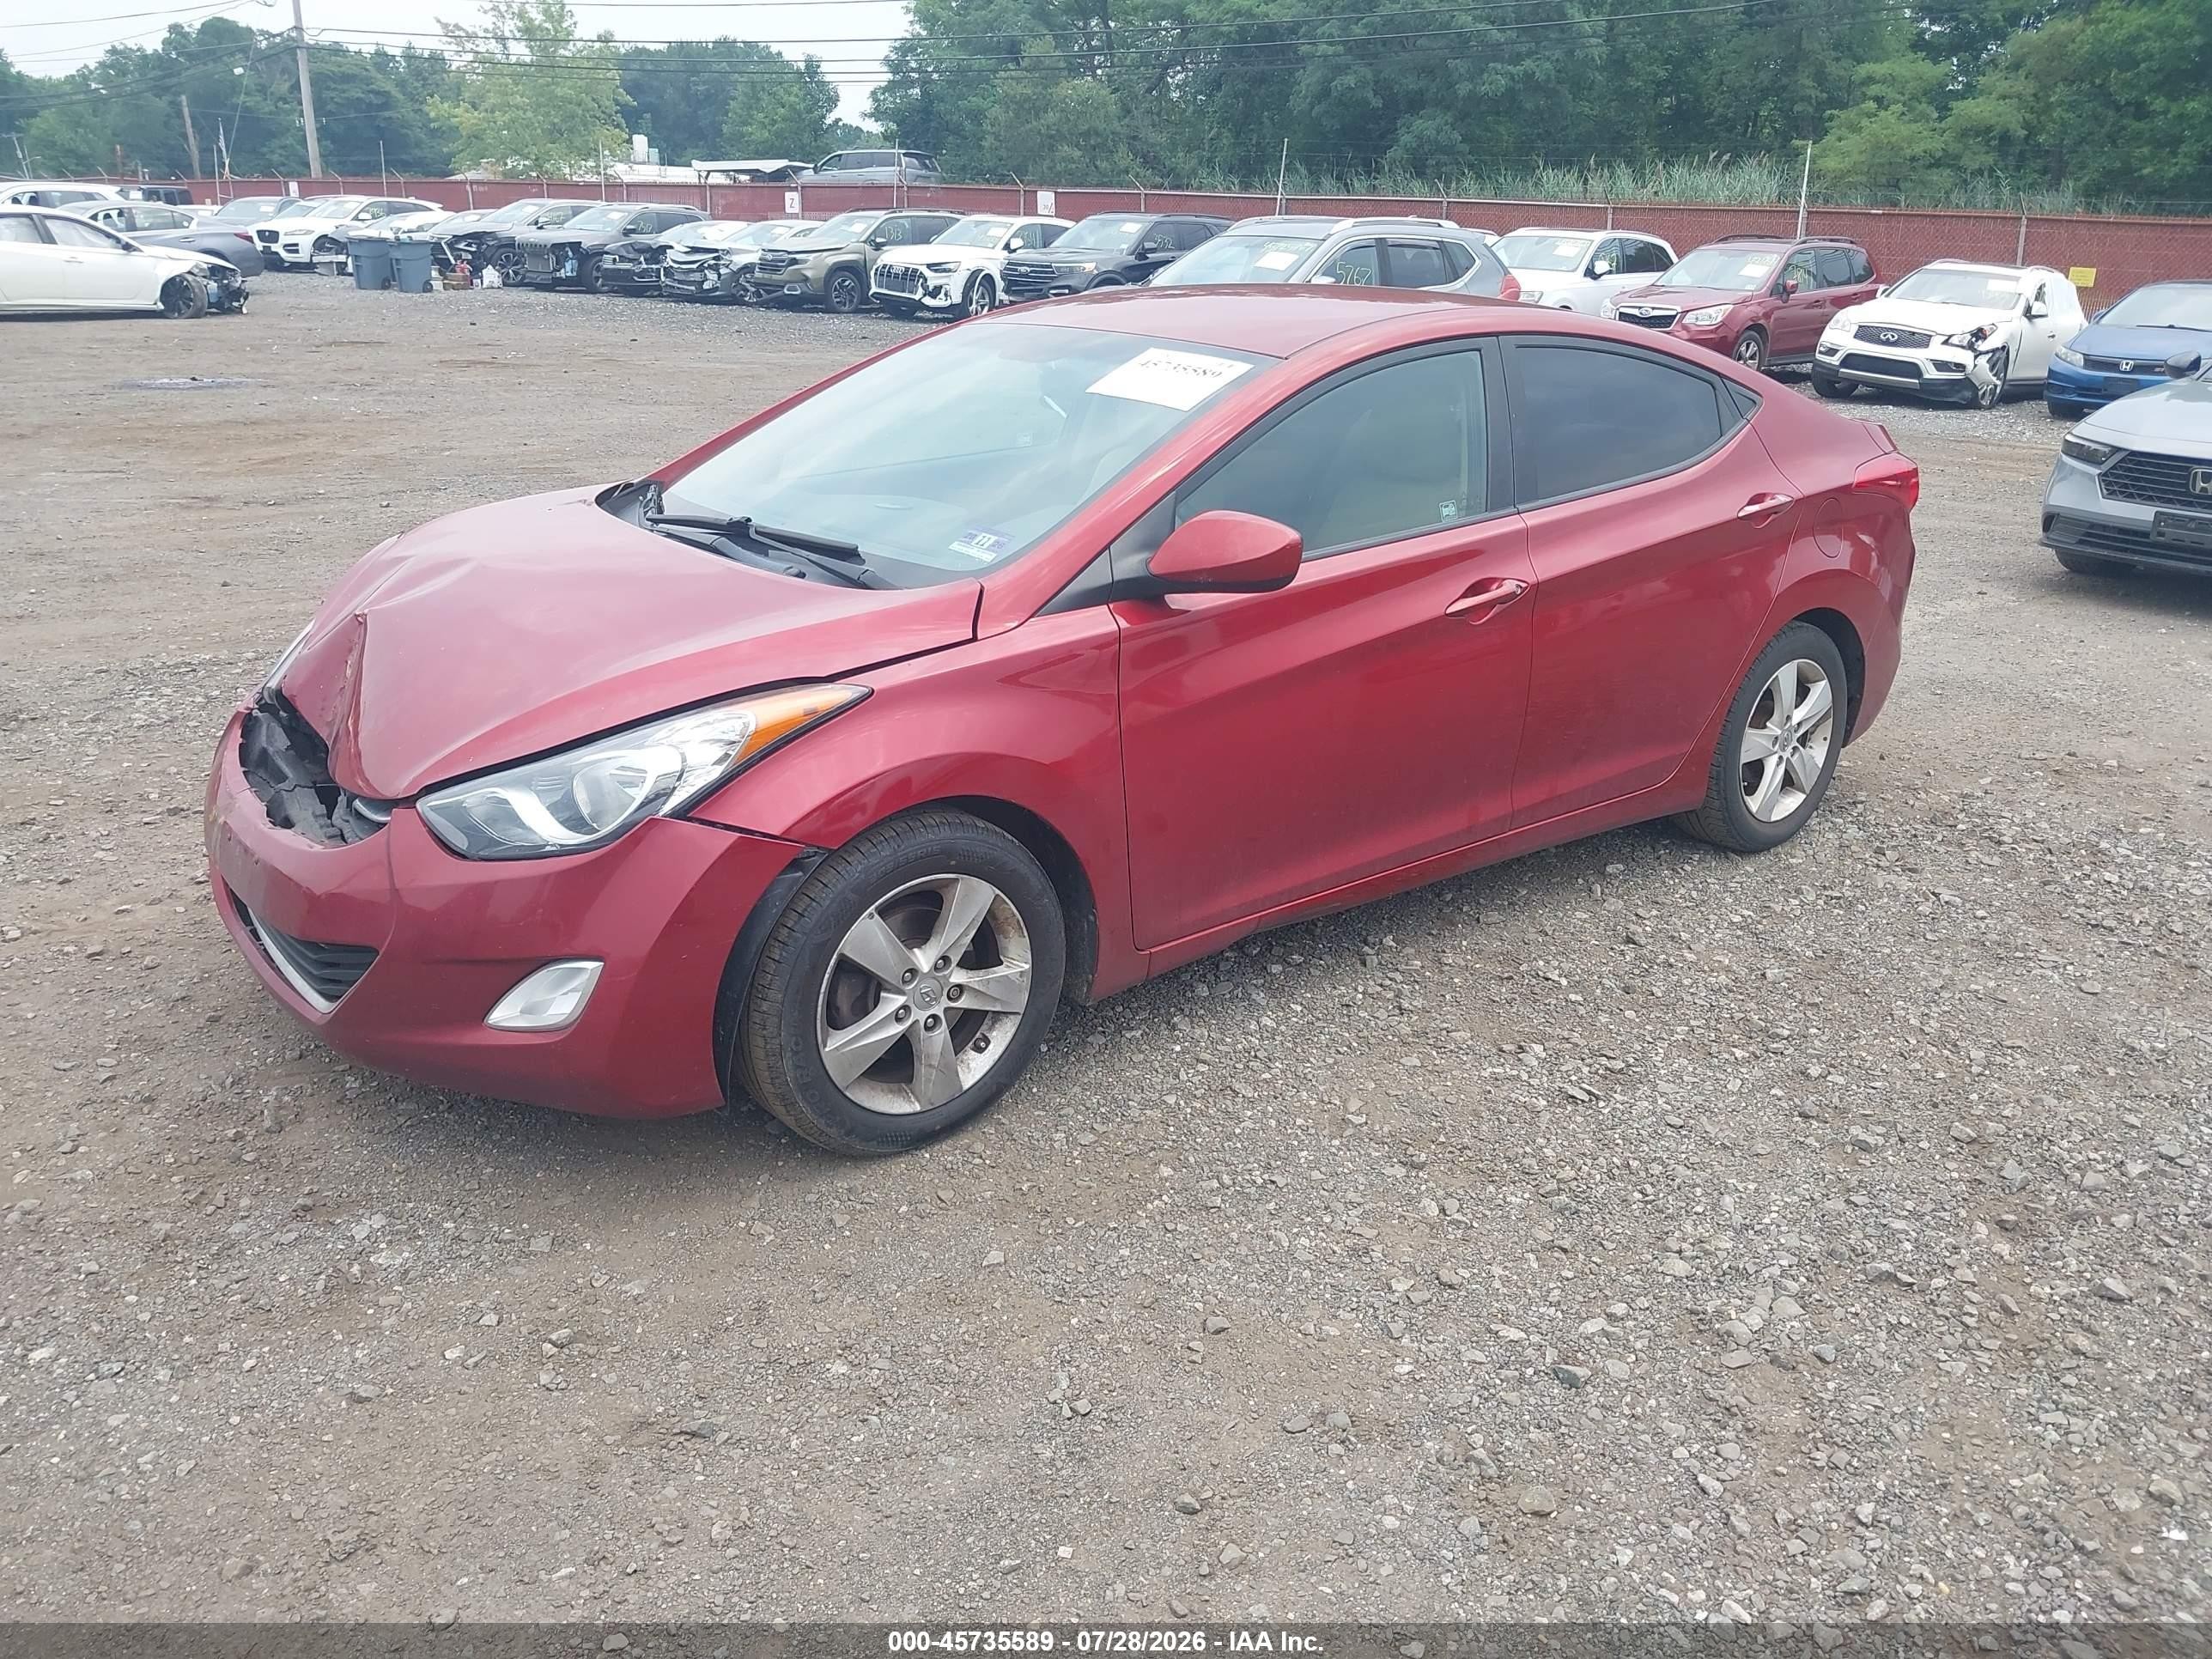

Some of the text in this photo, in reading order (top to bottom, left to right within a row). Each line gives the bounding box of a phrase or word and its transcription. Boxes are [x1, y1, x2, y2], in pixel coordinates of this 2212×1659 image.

[789, 198, 795, 209] Z
[1336, 261, 1372, 285] 5767
[974, 535, 992, 547] 11
